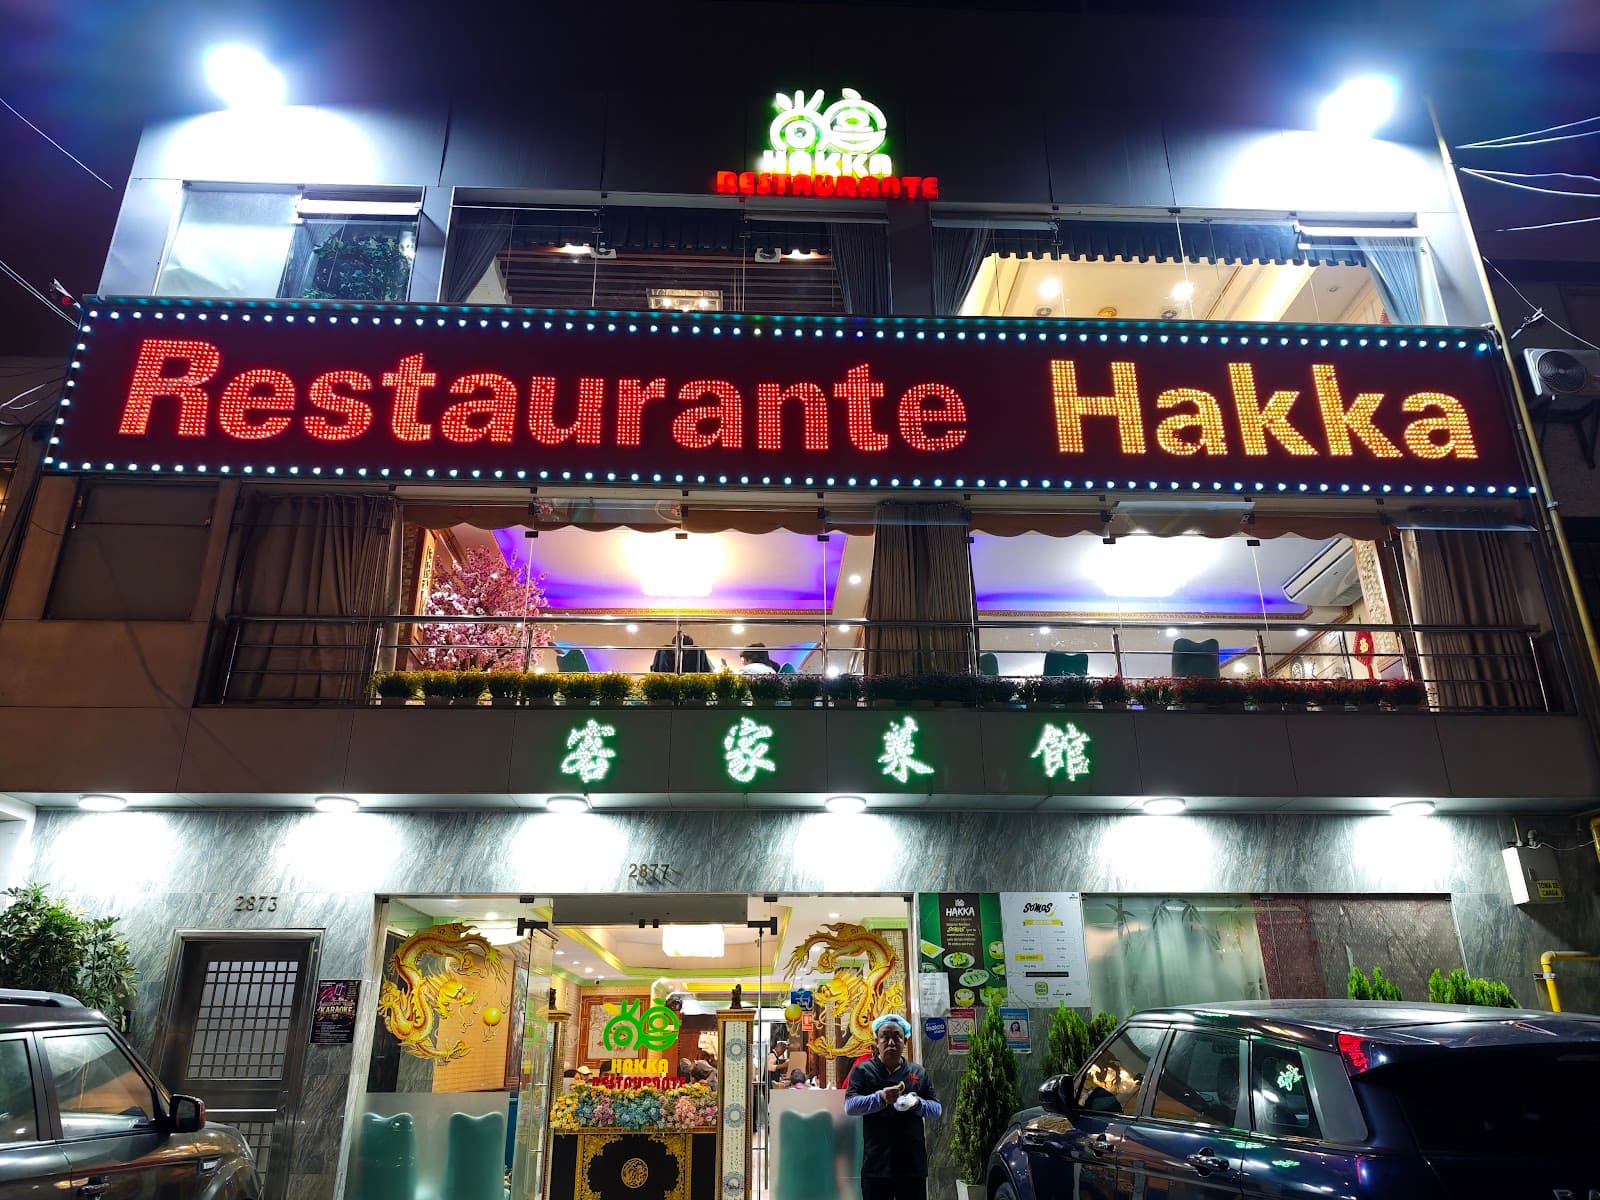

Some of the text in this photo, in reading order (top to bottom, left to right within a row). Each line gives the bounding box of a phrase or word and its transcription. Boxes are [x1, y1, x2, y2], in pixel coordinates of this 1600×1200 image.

[762, 150, 893, 178] HAKKA
[716, 171, 939, 199] RESTAURANTE
[118, 338, 1480, 460] Restaurante Hakka
[629, 863, 670, 879] 2877
[234, 895, 278, 912] 2873
[945, 906, 975, 917] HAKKA
[319, 1005, 353, 1016] KARAOKE
[611, 1058, 669, 1074] HAKKA
